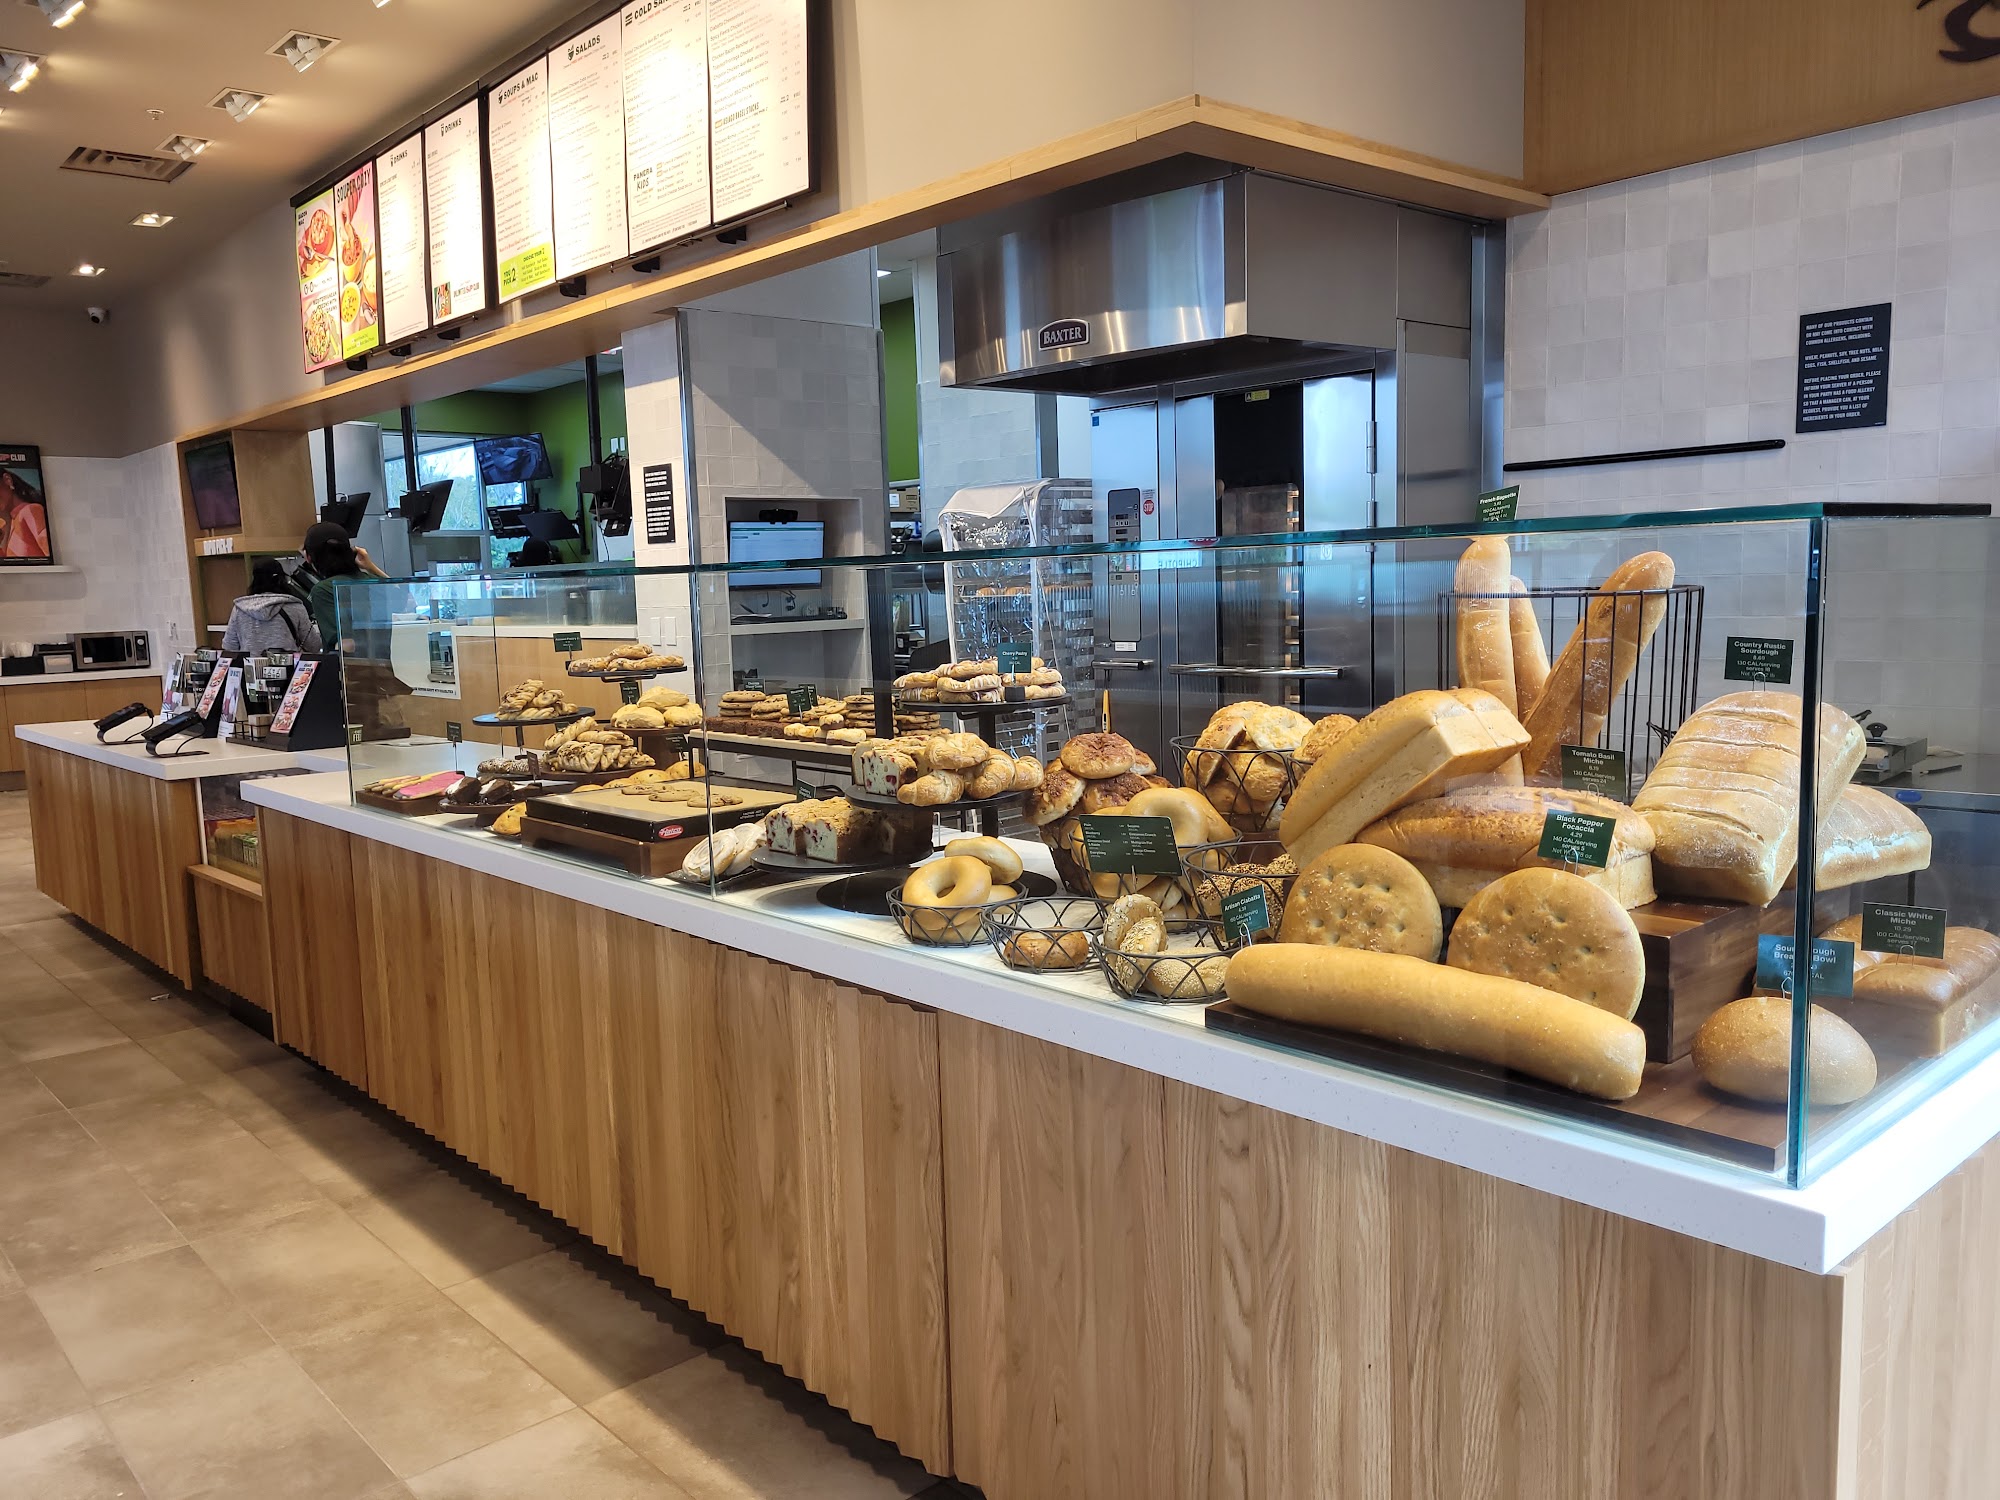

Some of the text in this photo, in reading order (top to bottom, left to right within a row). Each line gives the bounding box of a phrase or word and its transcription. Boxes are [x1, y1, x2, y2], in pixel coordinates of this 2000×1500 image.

[634, 2, 652, 20] COLD
[575, 34, 600, 56] SALADS
[503, 72, 539, 100] SOUPS & MAC
[445, 117, 462, 133] DRINKS
[394, 150, 408, 165] DRINKS
[633, 167, 653, 191] PANERA KIDS
[336, 178, 356, 203] SOUPER
[512, 268, 516, 282] 2
[1044, 327, 1082, 344] BAXTER
[1144, 502, 1154, 512] STOP
[1734, 641, 1762, 649] Country
[1740, 648, 1778, 656] Sourdough
[1572, 750, 1597, 758] Tomato
[1583, 771, 1615, 781] CAL/serving
[1556, 814, 1604, 827] Black Pepper
[1562, 822, 1594, 833] Focaccia
[1563, 837, 1598, 848] CAL/serving
[1224, 894, 1260, 911] Artisan Ciabatta
[1875, 909, 1933, 920] Classic White
[1890, 917, 1916, 925] Miche
[1888, 933, 1929, 942] CAL/serving
[1776, 944, 1835, 956] Souough
[1774, 952, 1836, 963] Brea Bowl
